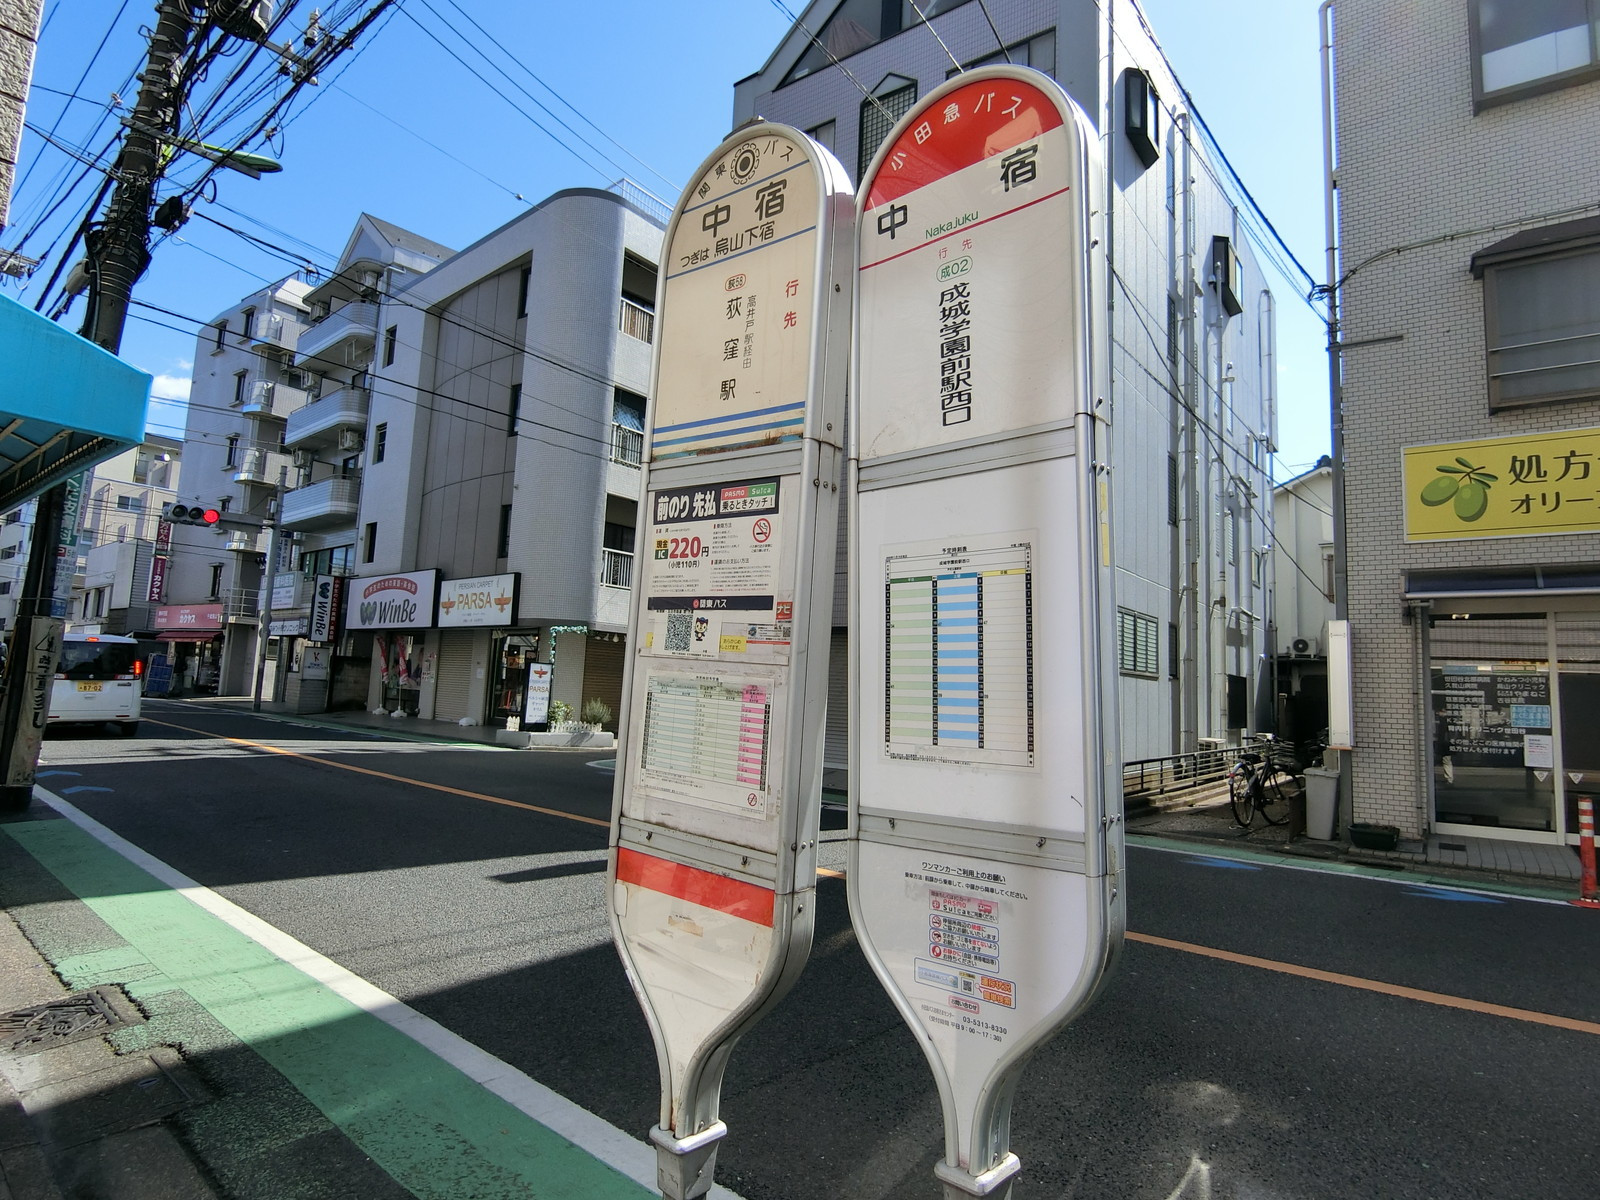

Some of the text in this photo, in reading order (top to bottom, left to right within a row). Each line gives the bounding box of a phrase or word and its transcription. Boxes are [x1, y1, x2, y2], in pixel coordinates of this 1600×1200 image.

[891, 93, 1022, 171] 小田急バス
[878, 144, 1038, 240] 中宿
[702, 179, 787, 238] 中宿
[925, 211, 979, 239] Nakajuku
[681, 221, 775, 267] つぎは 烏山下宿
[939, 238, 972, 260] 行先
[941, 259, 968, 279] 成02
[784, 280, 799, 329] 行先
[743, 295, 756, 368] 高井戸駅経由
[720, 297, 742, 400] 荻窪駅
[939, 282, 972, 426] 成城学園前駅西口
[1508, 450, 1600, 485] 処方
[724, 487, 771, 497] PASMO Suica
[1510, 491, 1600, 514] オリー
[657, 490, 717, 521] 前のり 先払
[656, 540, 668, 548] 現金
[658, 550, 666, 558] IC
[151, 575, 161, 600] カクヤス
[378, 598, 417, 624] WinBe
[457, 592, 493, 610] PARSA
[699, 599, 727, 608] 関東バス
[315, 601, 328, 636] WinBe
[529, 685, 550, 693] PARSA
[943, 899, 966, 909] PASMO
[962, 1016, 1007, 1035] 03-5313-8330
